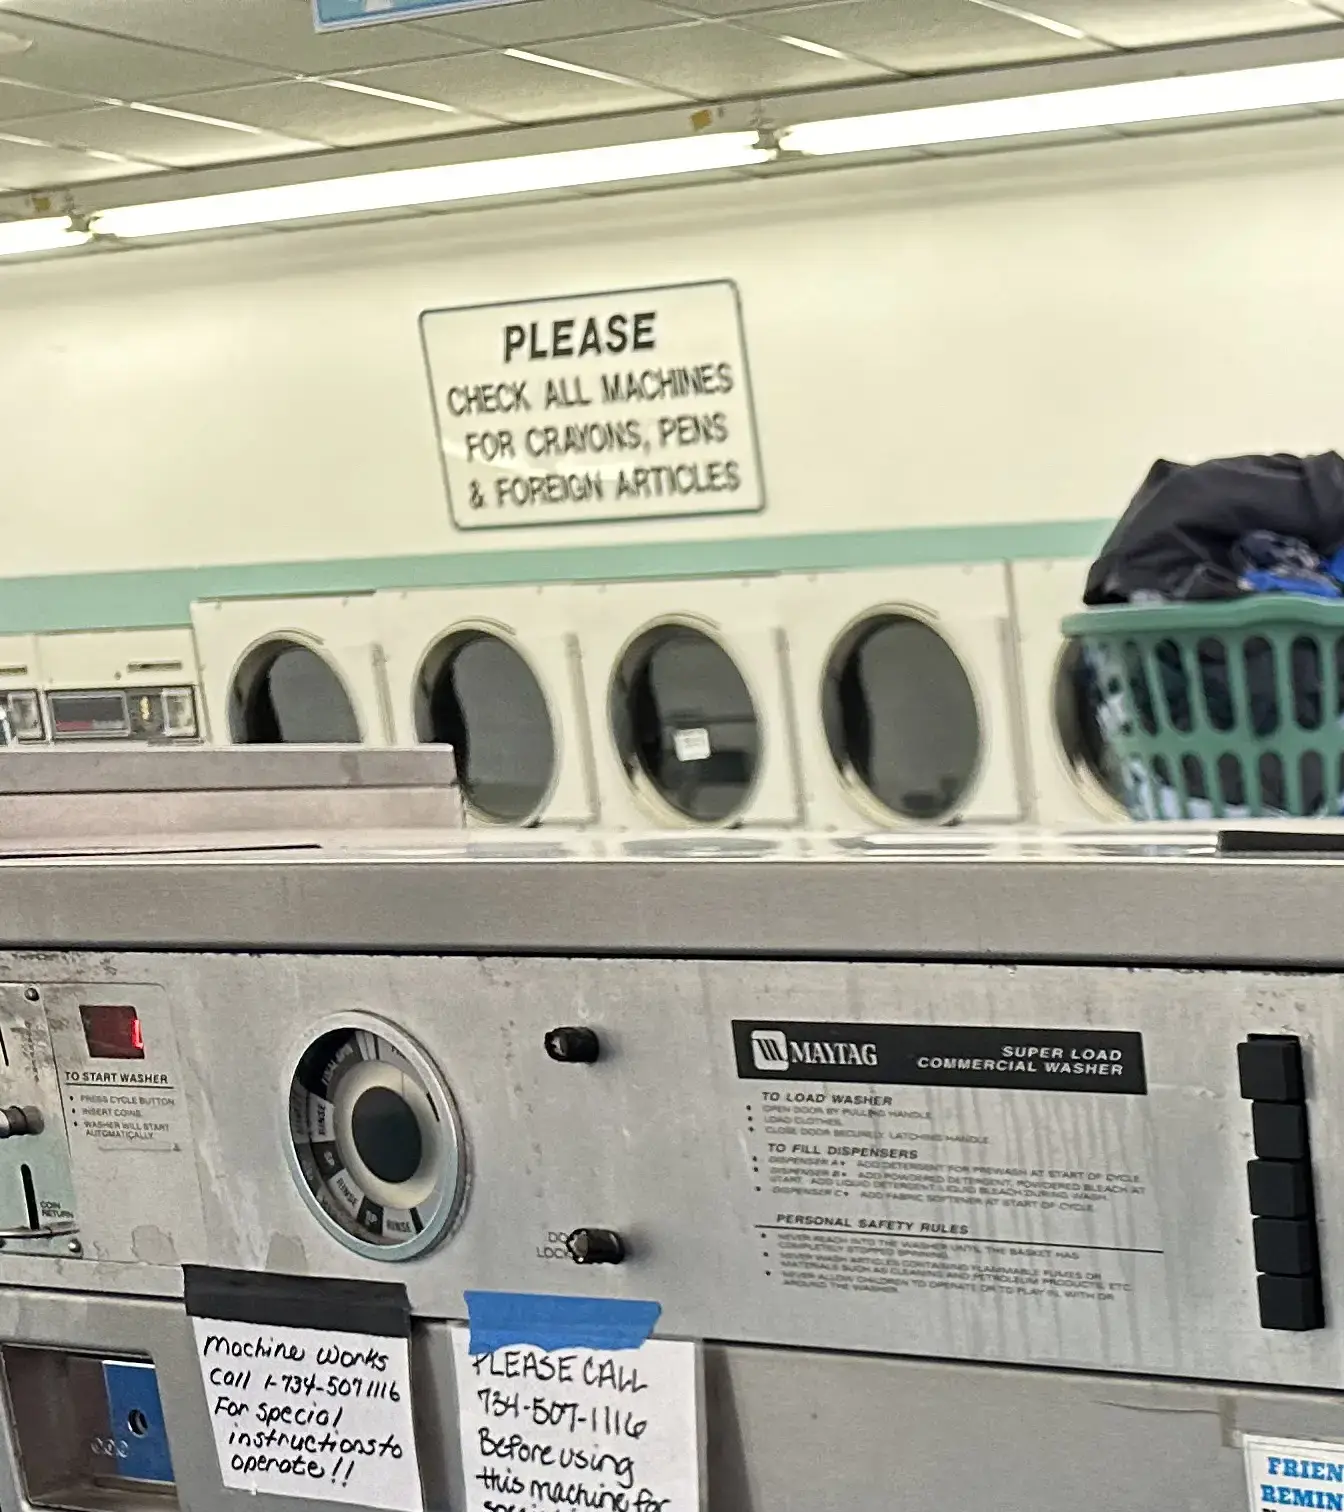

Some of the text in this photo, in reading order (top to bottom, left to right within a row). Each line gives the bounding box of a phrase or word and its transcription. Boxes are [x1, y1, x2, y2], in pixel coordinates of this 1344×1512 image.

[504, 312, 656, 362] PLEASE
[447, 361, 734, 416] CHECK ALL MACHINES
[465, 412, 728, 461] FOR CRAYONS, PENS
[468, 461, 741, 509] & FOREIGN ARTICLES
[790, 1041, 878, 1066] MAYTAG
[917, 1056, 1123, 1077] COMMERCIAL WASHER
[1001, 1045, 1122, 1062] SUPER LOAD
[64, 1071, 168, 1084] TO START WASHER
[762, 1092, 893, 1106] TO LOAD WASHER
[768, 1143, 918, 1160] TO FILL DISPENSERS
[776, 1213, 969, 1235] PERSONAL SAFETY RULES
[472, 1351, 648, 1393] PLEASE CALL
[215, 1396, 343, 1428] For special
[477, 1388, 647, 1439] 734-507-1116
[478, 1426, 634, 1489] Before using
[475, 1466, 525, 1493] this
